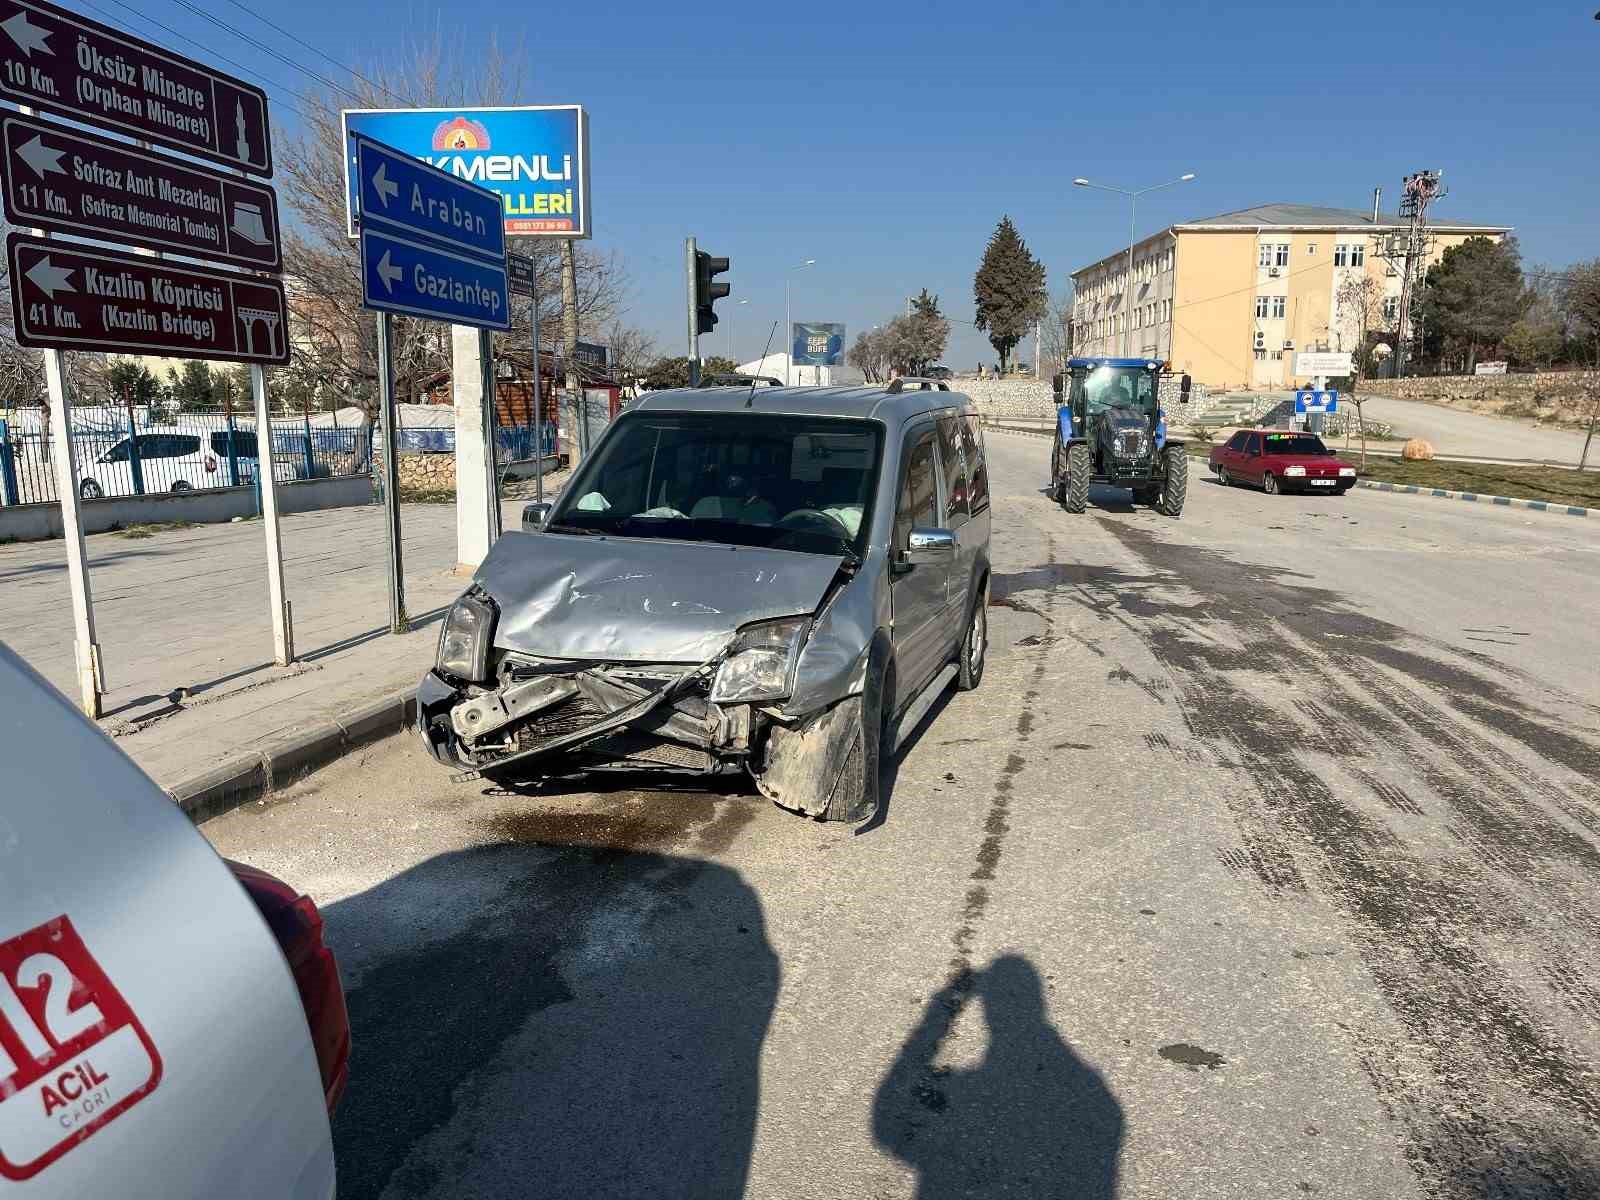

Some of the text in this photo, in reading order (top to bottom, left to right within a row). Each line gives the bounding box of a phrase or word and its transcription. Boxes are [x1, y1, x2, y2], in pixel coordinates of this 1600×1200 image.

[5, 59, 60, 97] 10 Km.
[77, 35, 205, 110] Öksüz Minare
[76, 75, 210, 143] (Orphan Minaret)
[20, 183, 73, 216] 11 Km.
[73, 156, 221, 214] Sofraz Anıt Mezarları
[410, 182, 486, 236] Araban
[494, 188, 573, 214] LLERİ
[81, 193, 220, 245] (Sofraz Memorial Tombs)
[84, 266, 224, 312] Kızılin Köprüsü
[414, 263, 500, 316] Gaziantep
[29, 303, 81, 329] 41 Km.
[102, 304, 216, 342] (Kızılin Bridge)
